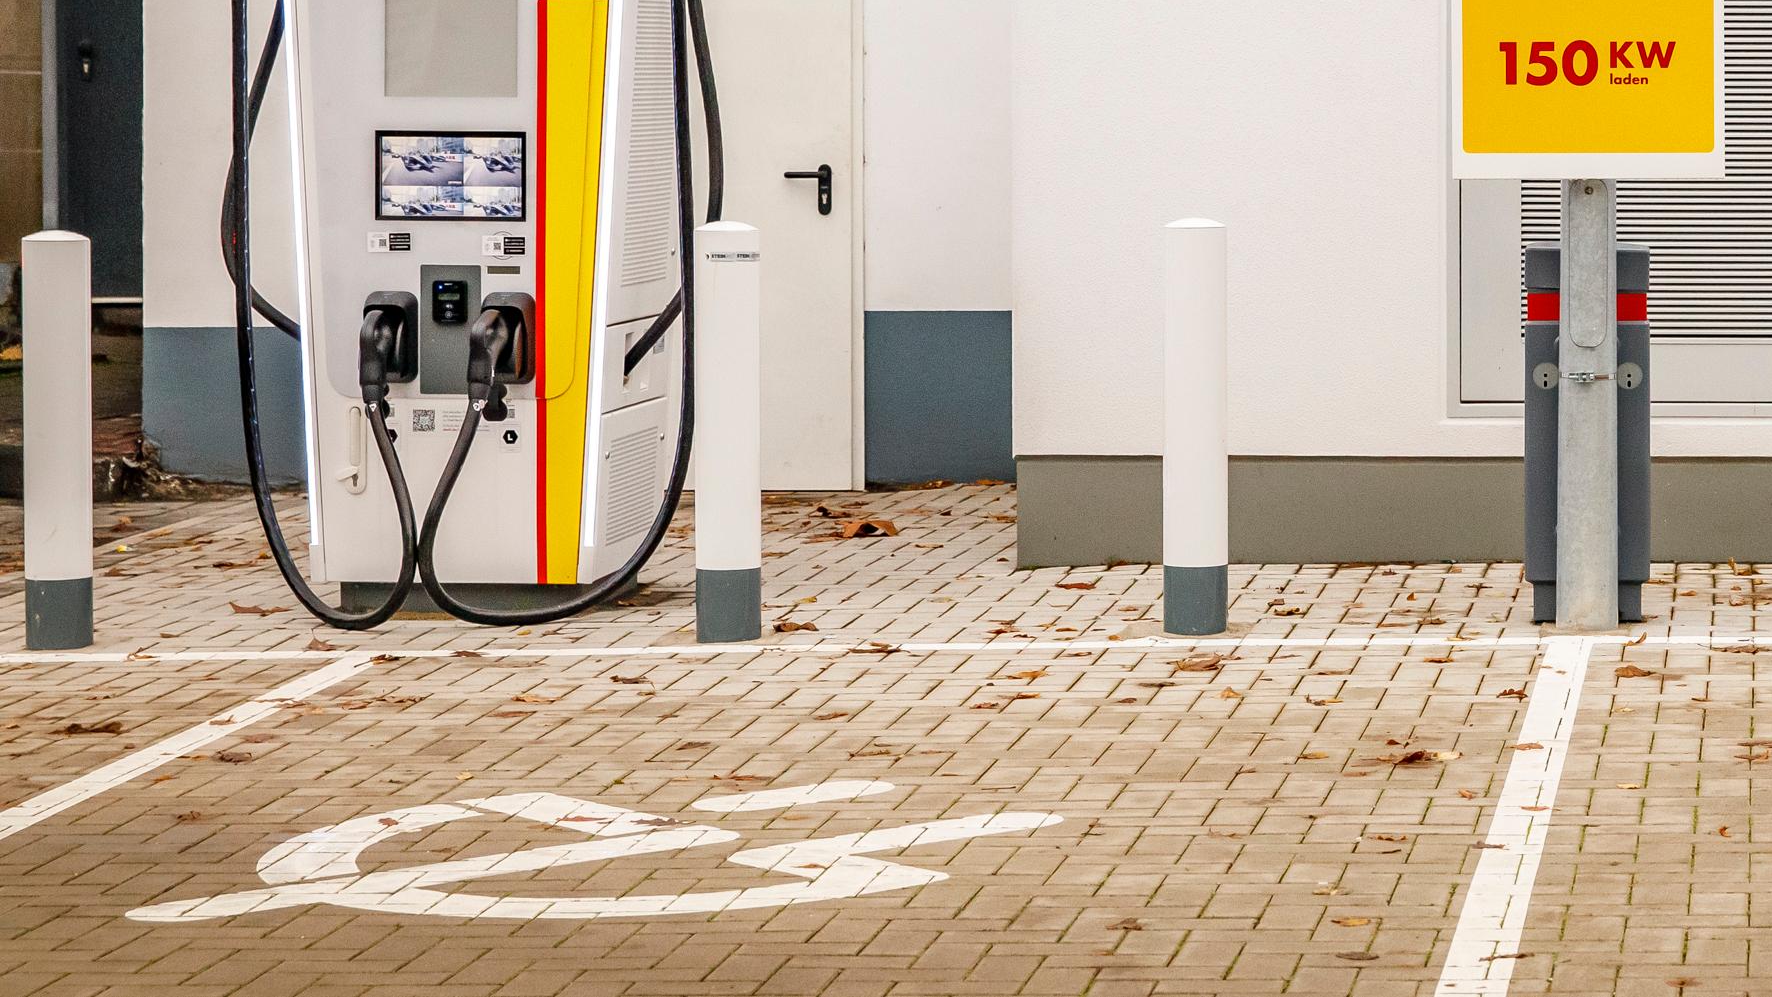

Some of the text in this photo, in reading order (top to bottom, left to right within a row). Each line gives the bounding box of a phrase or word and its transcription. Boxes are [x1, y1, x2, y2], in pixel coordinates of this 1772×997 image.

[1499, 40, 1676, 86] 150 KW
[1609, 73, 1649, 85] laden
